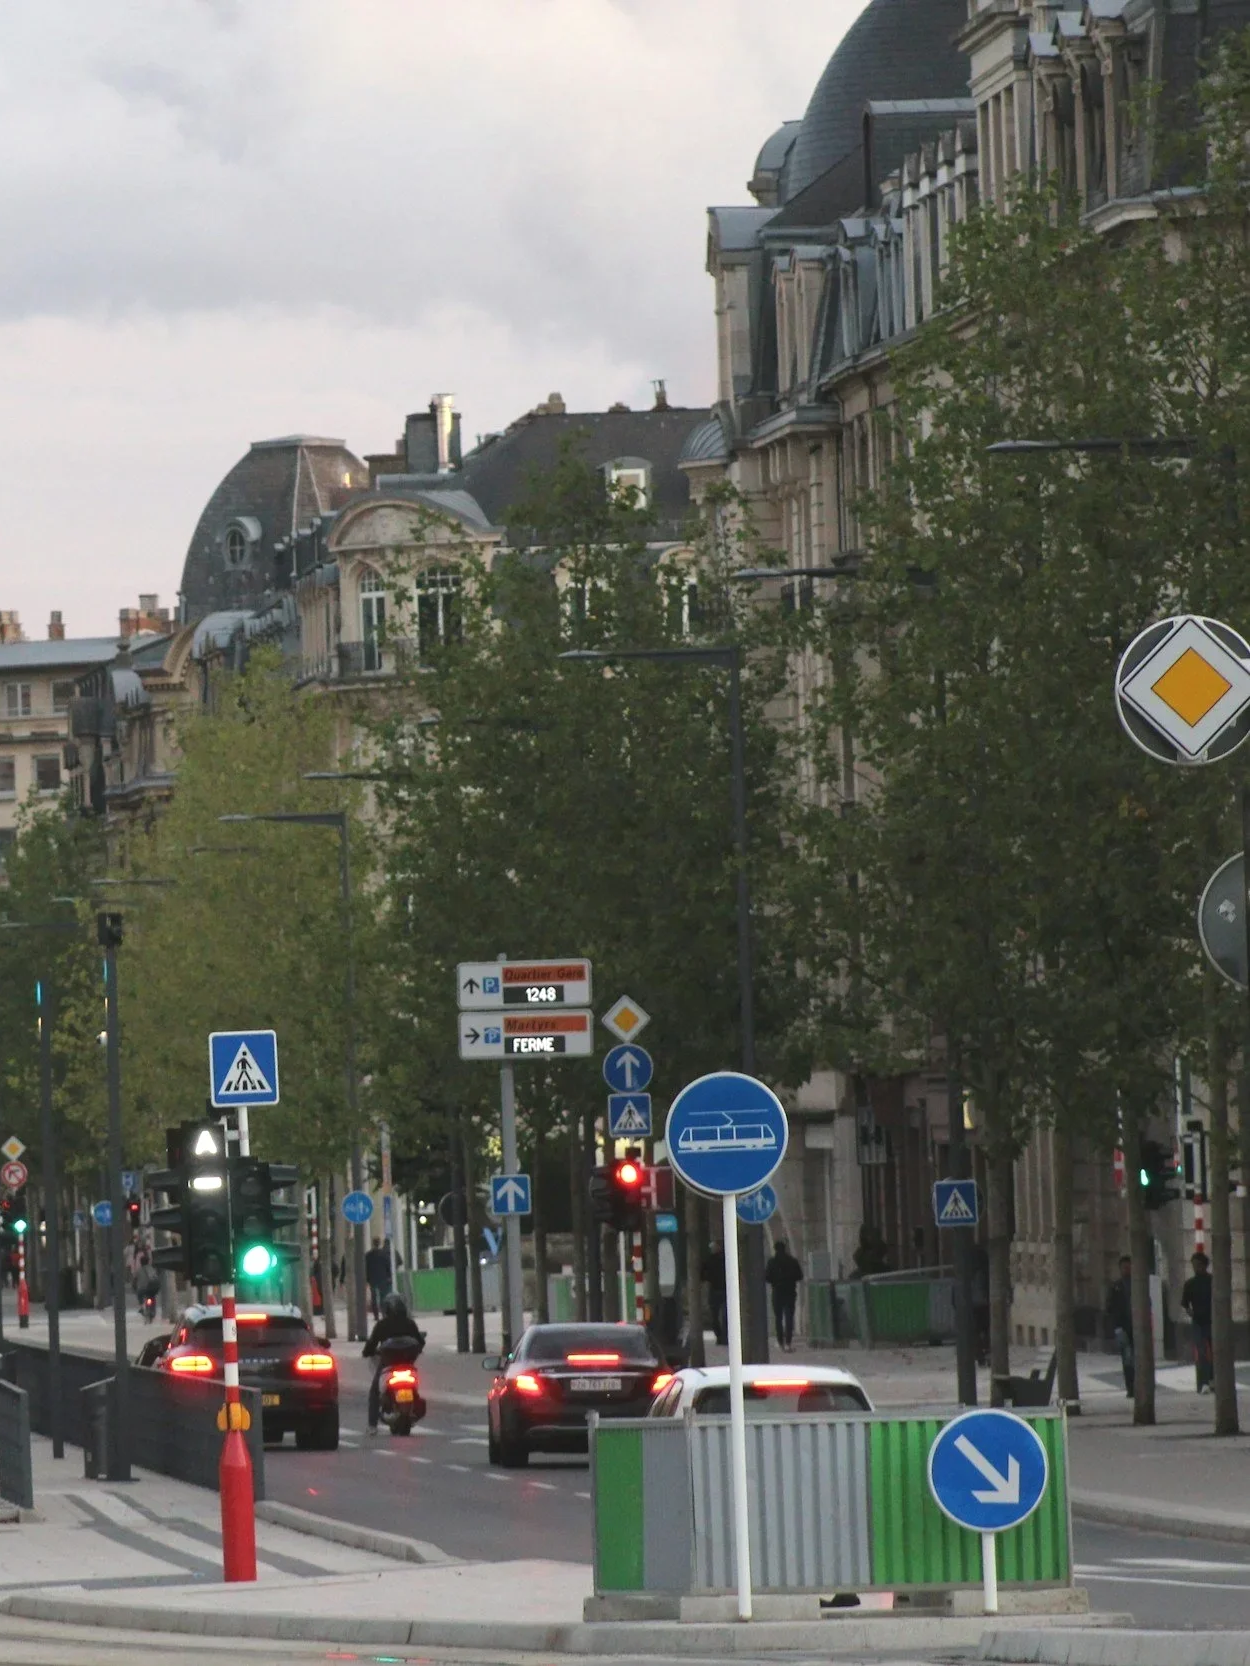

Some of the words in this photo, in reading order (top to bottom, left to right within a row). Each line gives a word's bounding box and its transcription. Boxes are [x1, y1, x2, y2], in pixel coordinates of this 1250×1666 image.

[505, 968, 551, 981] Quartier
[526, 986, 556, 1002] 1248
[506, 1018, 556, 1032] Martyrs
[513, 1037, 554, 1053] FERME
